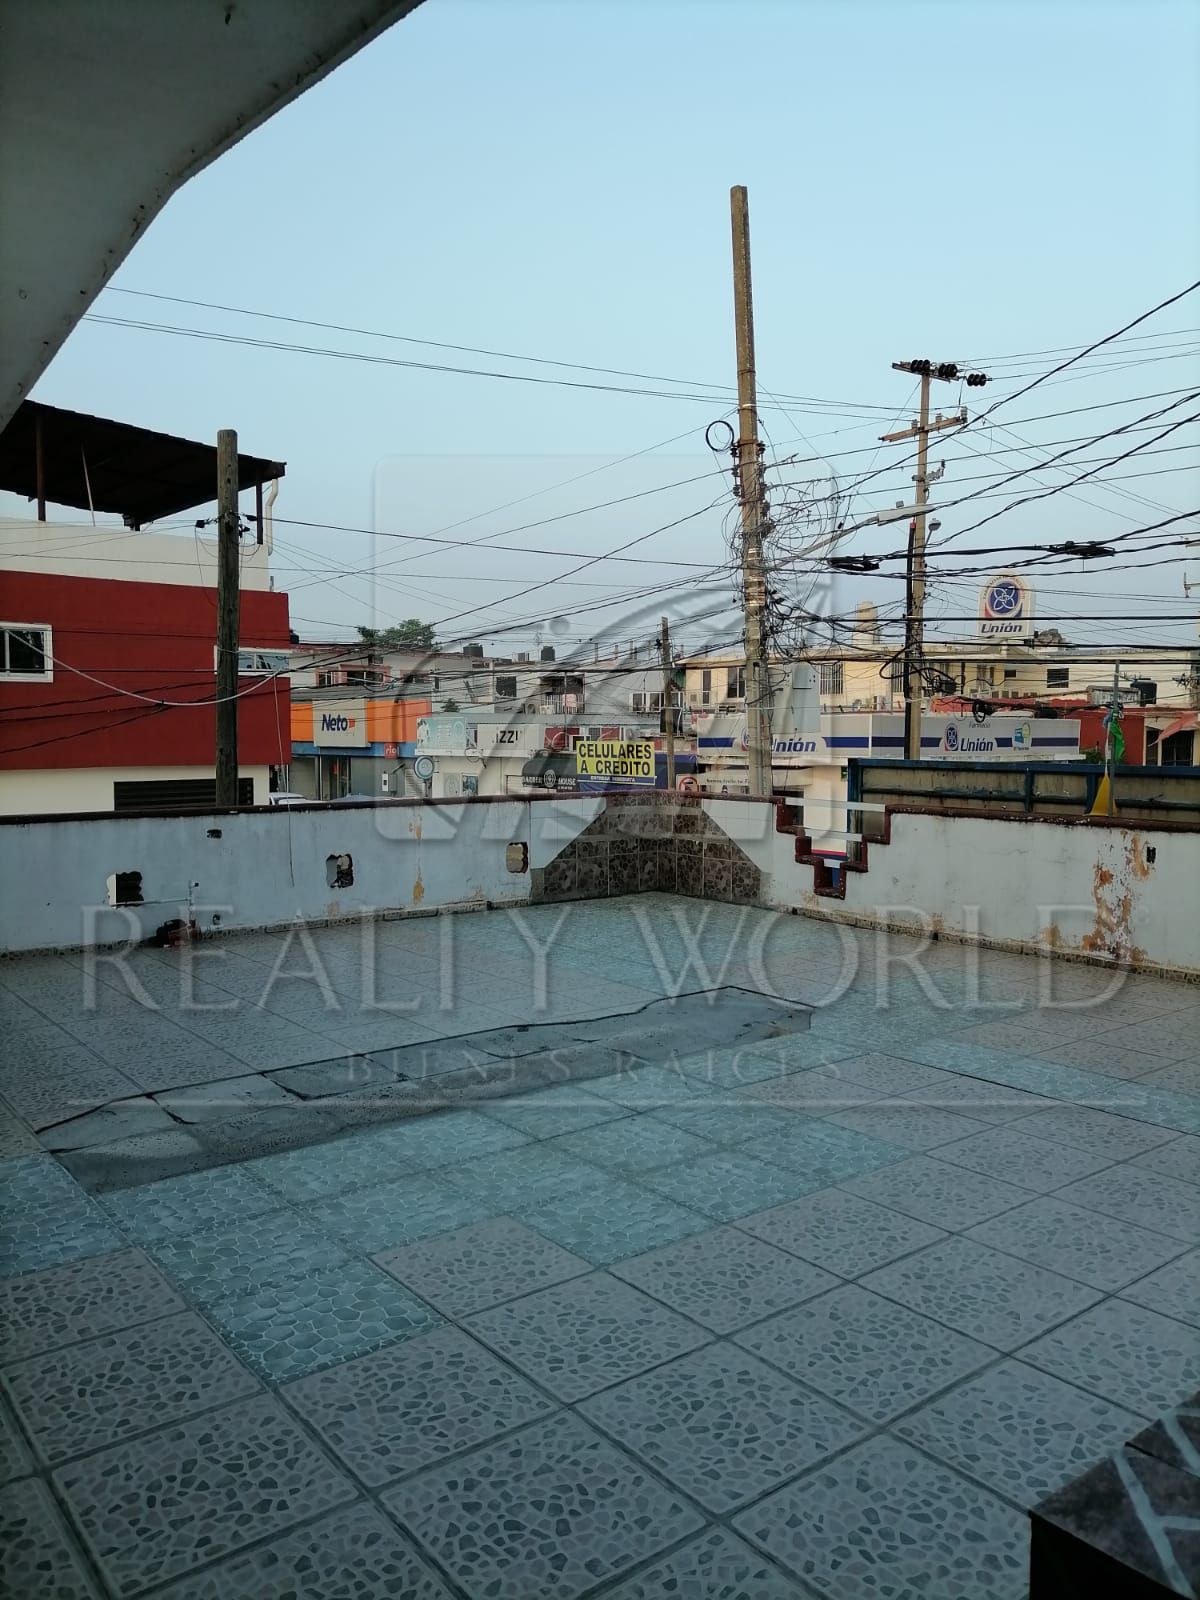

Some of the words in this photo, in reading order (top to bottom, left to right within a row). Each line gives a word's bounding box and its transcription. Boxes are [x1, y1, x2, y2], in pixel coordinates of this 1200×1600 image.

[981, 622, 1022, 633] Unión
[321, 713, 348, 731] Neto
[579, 743, 651, 759] CELULARES
[960, 737, 993, 752] Unión
[580, 760, 588, 774] A
[596, 760, 650, 776] CREDITO
